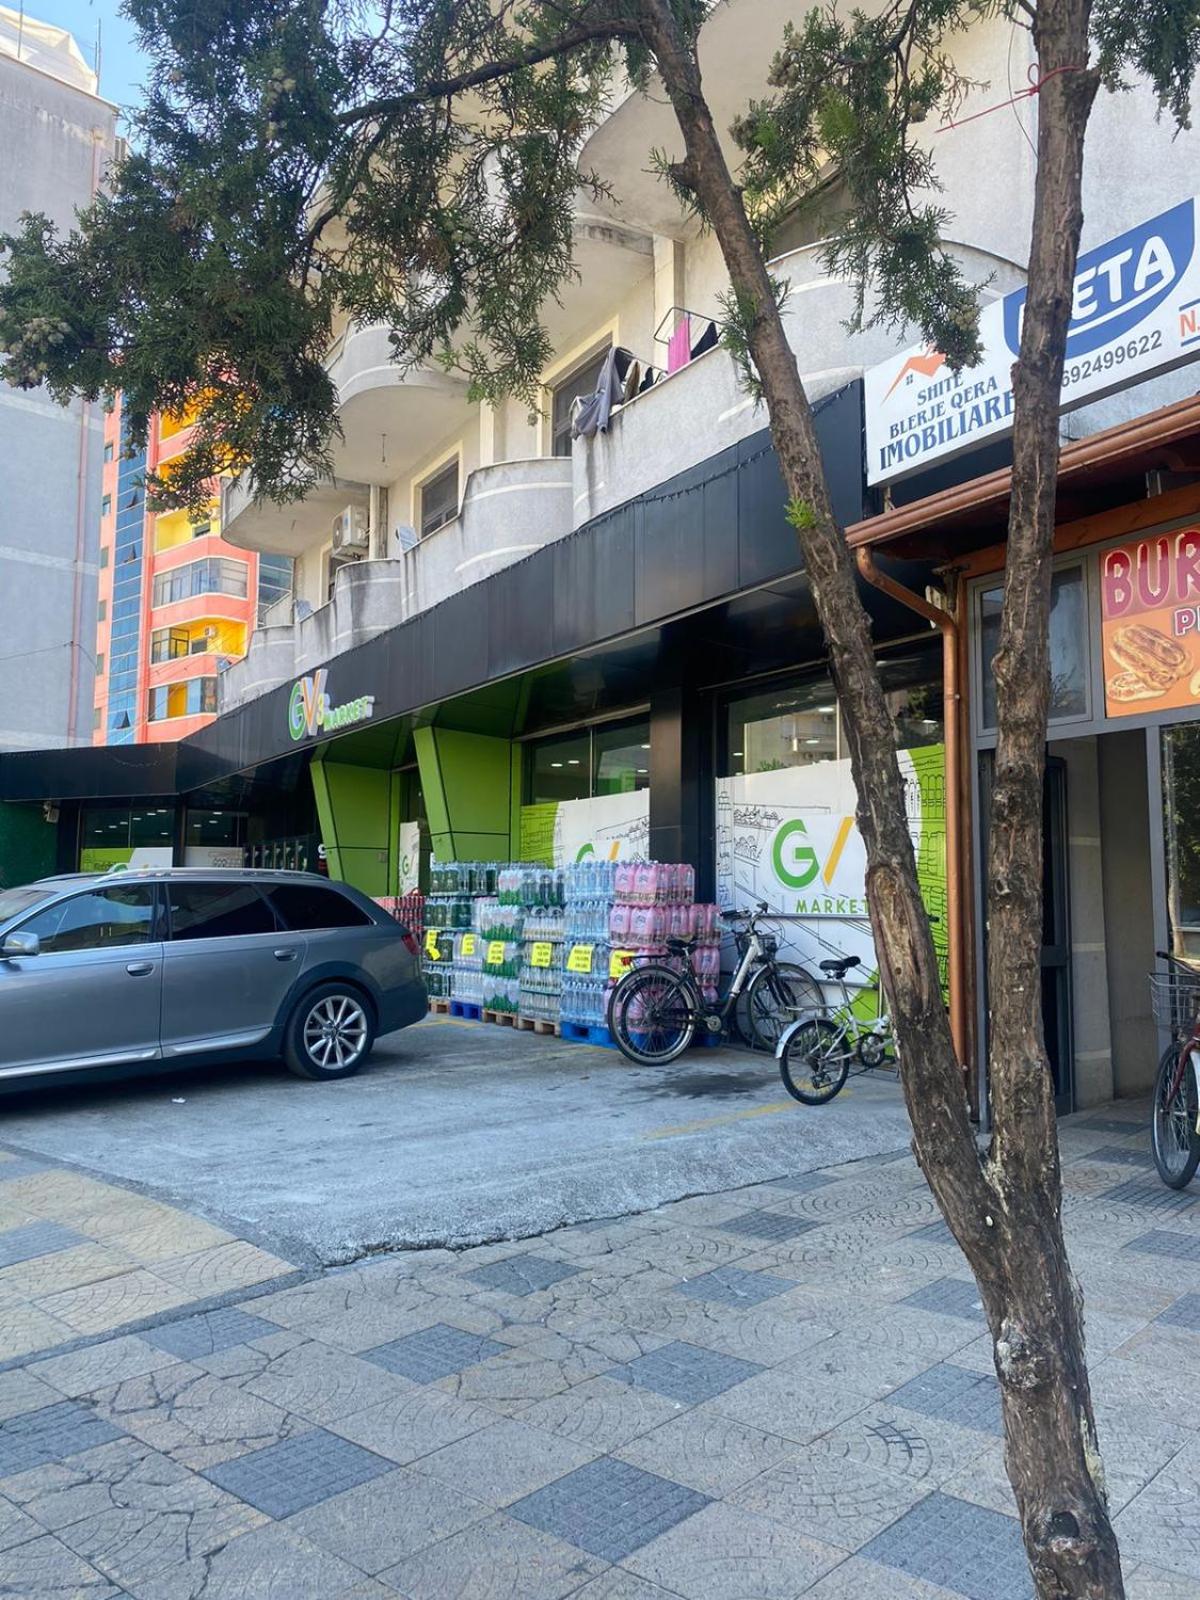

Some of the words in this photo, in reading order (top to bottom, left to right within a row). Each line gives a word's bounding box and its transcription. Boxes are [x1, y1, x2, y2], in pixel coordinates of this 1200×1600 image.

[1062, 329, 1162, 387] 692499622
[889, 401, 946, 439] BLERJE
[950, 376, 998, 409] QERA
[917, 371, 964, 406] SHITE
